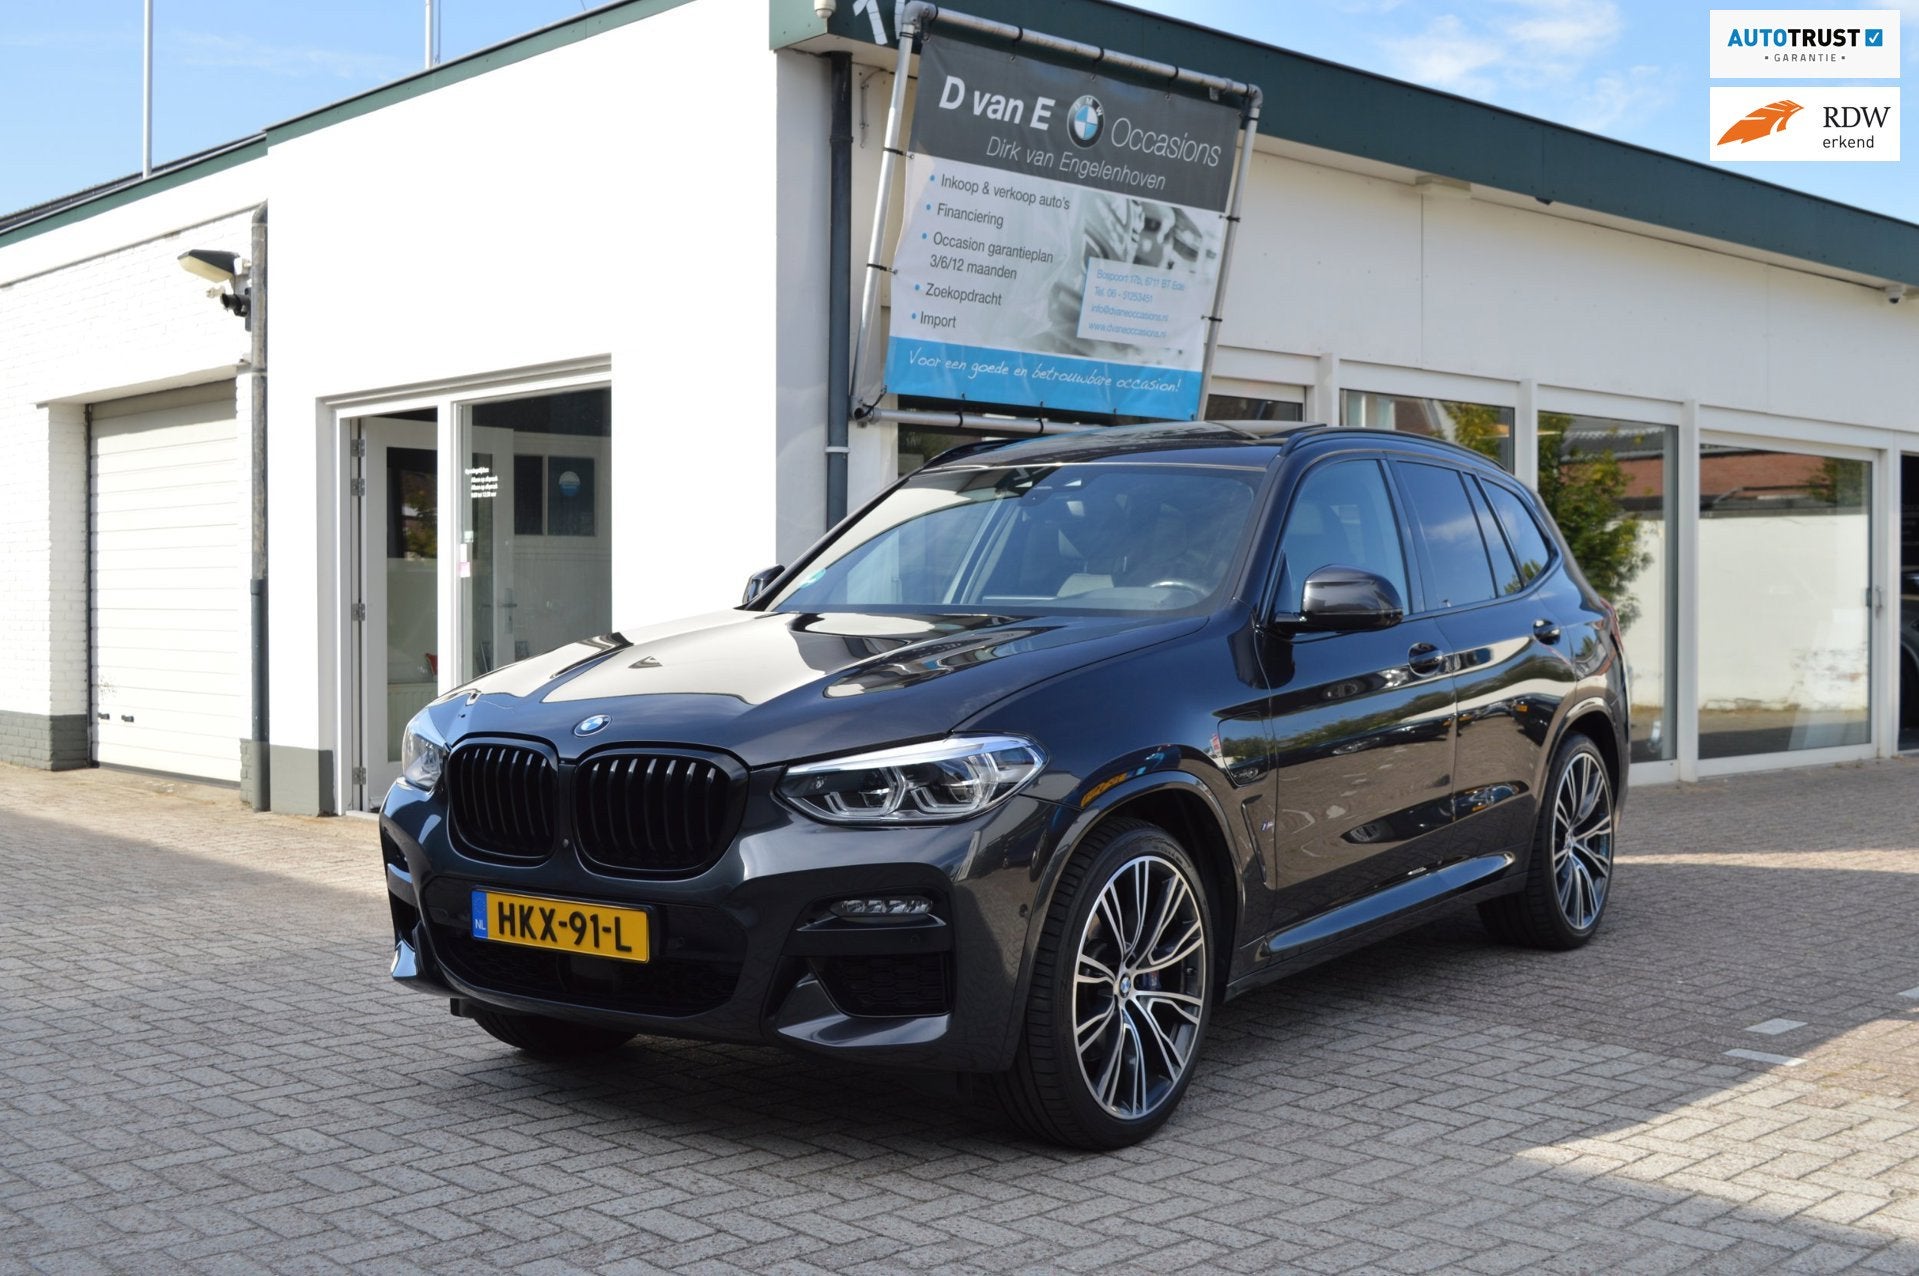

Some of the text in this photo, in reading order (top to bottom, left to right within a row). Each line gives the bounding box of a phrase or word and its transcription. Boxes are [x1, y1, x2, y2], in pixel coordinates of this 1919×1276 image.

[939, 76, 1055, 131] D van E
[1110, 117, 1221, 168] Occasions
[986, 136, 1166, 191] Dirk van Engelenhoven
[941, 174, 1070, 210] Inkoop & verkoop auto's
[937, 202, 1004, 229] Financiering
[933, 231, 1054, 264] Occasion garantieplan
[930, 254, 1018, 280] 3/6/12 maanden
[925, 282, 1002, 306] Zoekopdracht
[920, 311, 957, 329] Import
[909, 347, 1182, 393] Voor een goede en betrouwbare occasion!
[475, 901, 632, 953] NL HKX-91-L
